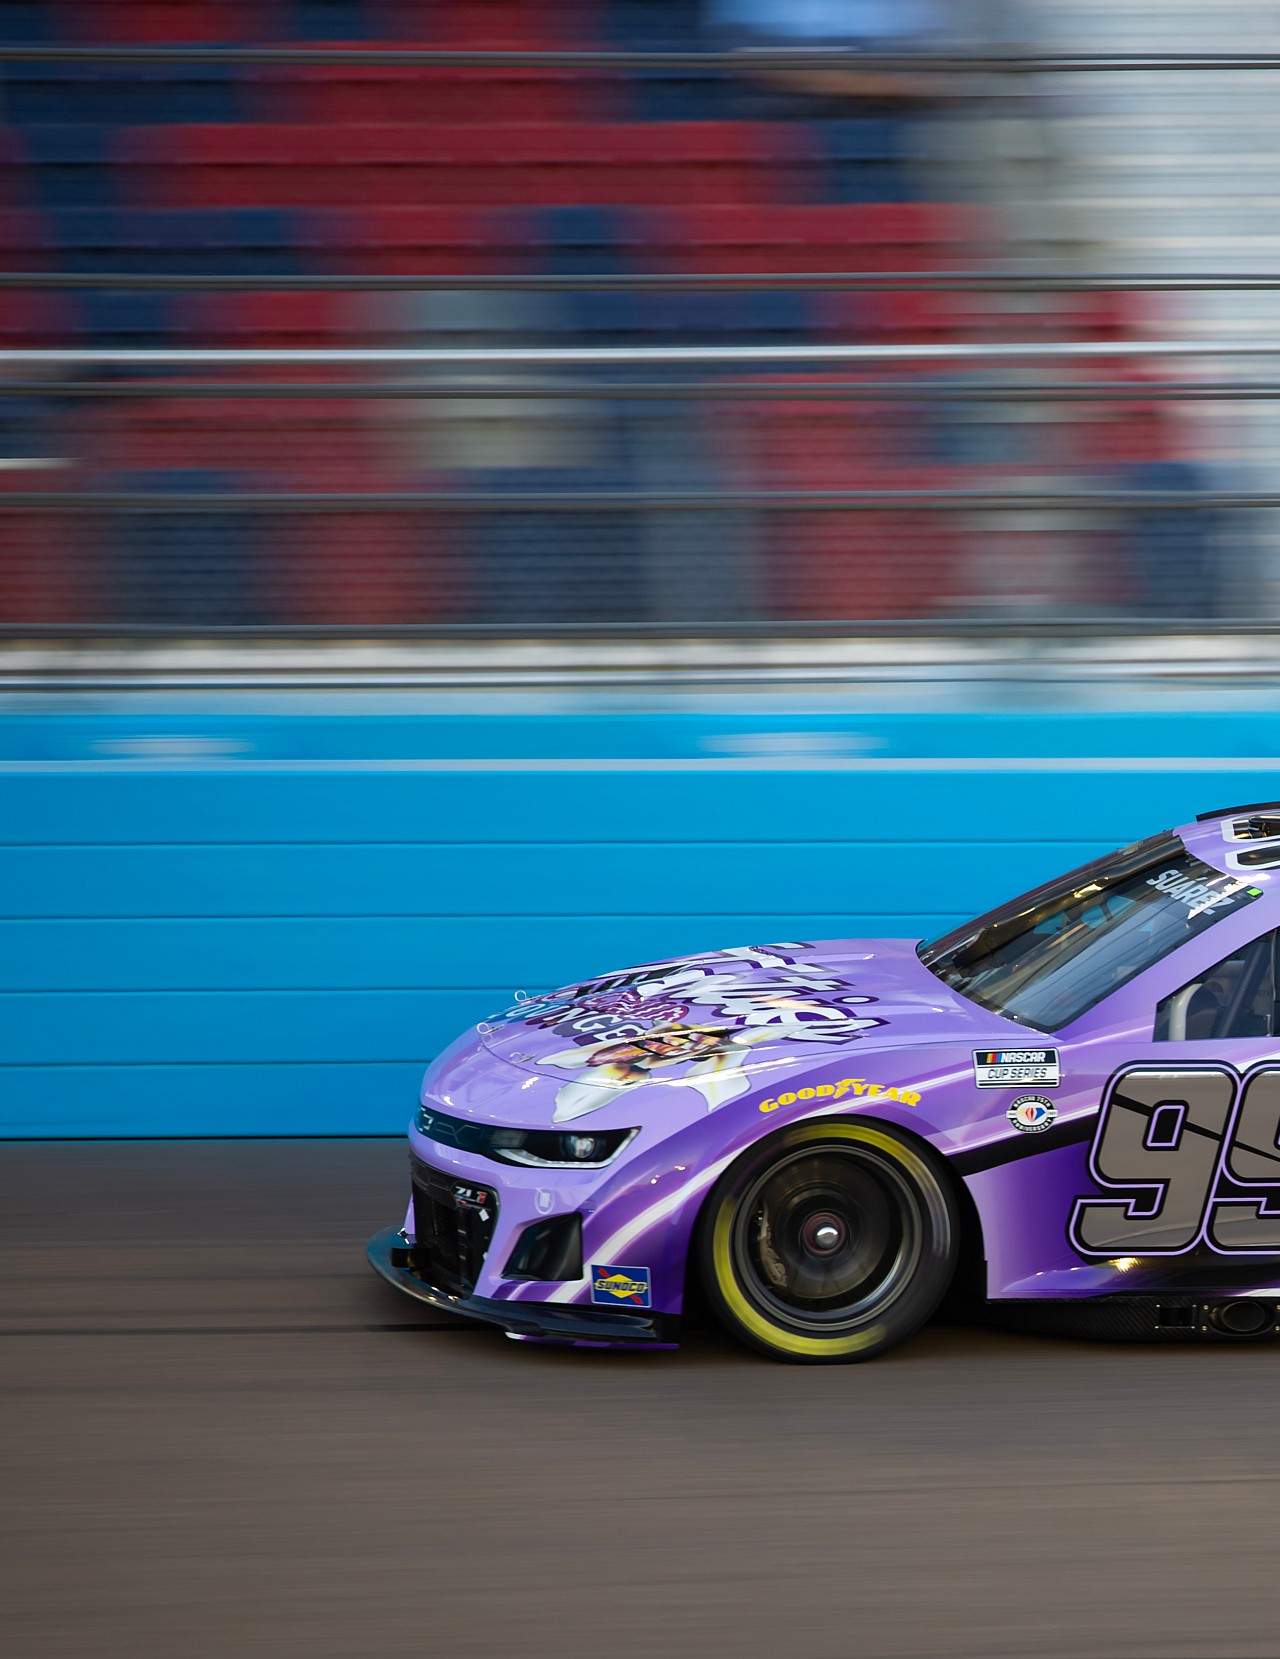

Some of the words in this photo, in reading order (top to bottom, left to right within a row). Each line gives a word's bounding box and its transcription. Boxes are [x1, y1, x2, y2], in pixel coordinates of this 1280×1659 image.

[488, 1002, 646, 1042] OUNGE
[1001, 1052, 1046, 1063] NASCAR
[988, 1069, 1009, 1079] CUP
[1010, 1068, 1047, 1078] SERIES
[758, 1078, 922, 1113] GOODYEAR
[597, 1280, 646, 1292] SUNOCO
